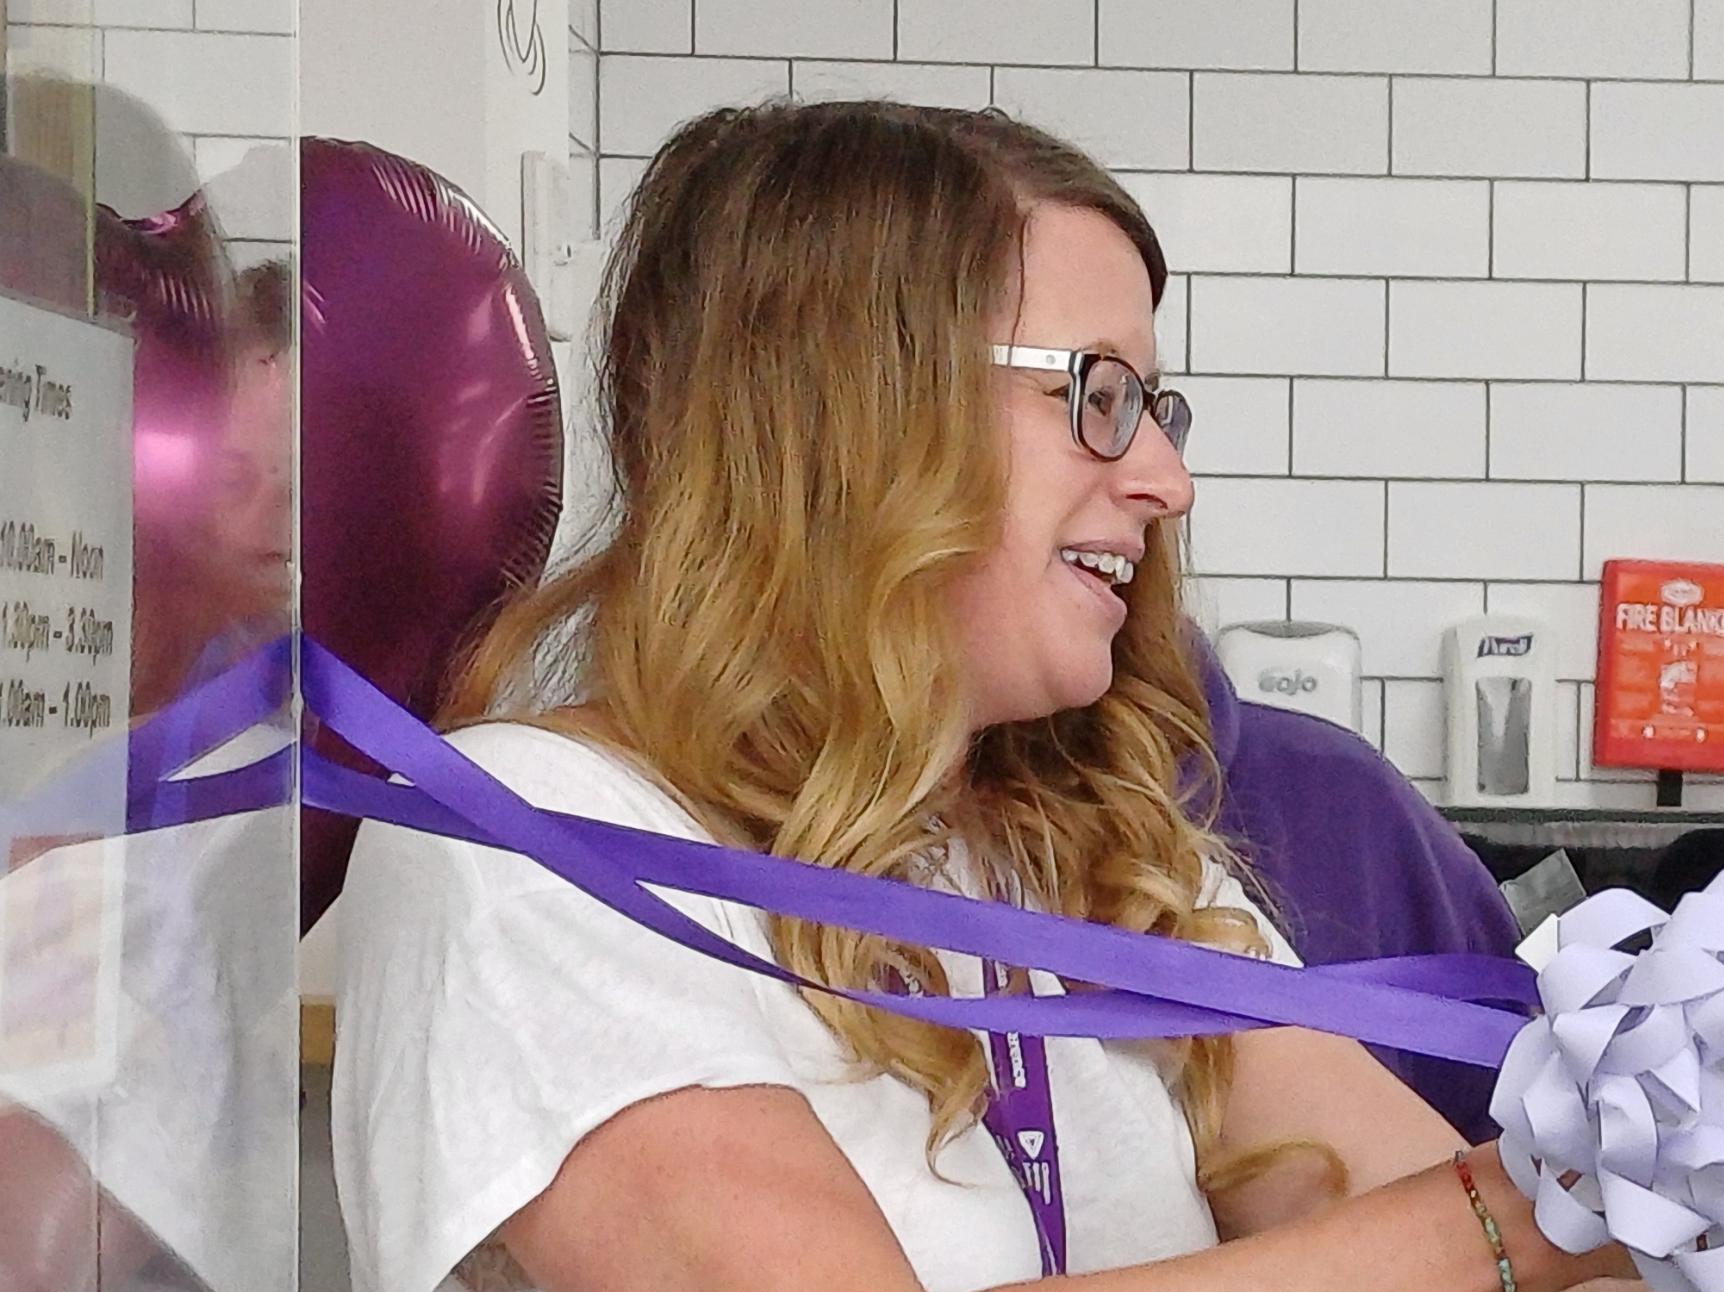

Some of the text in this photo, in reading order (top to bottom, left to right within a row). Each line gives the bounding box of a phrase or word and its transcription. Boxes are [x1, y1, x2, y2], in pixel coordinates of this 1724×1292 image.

[34, 364, 73, 420] Times
[70, 530, 104, 579] Noon
[65, 606, 113, 666] 3.30pm
[1616, 603, 1658, 632] FIRE
[63, 681, 110, 739] 1.00pm
